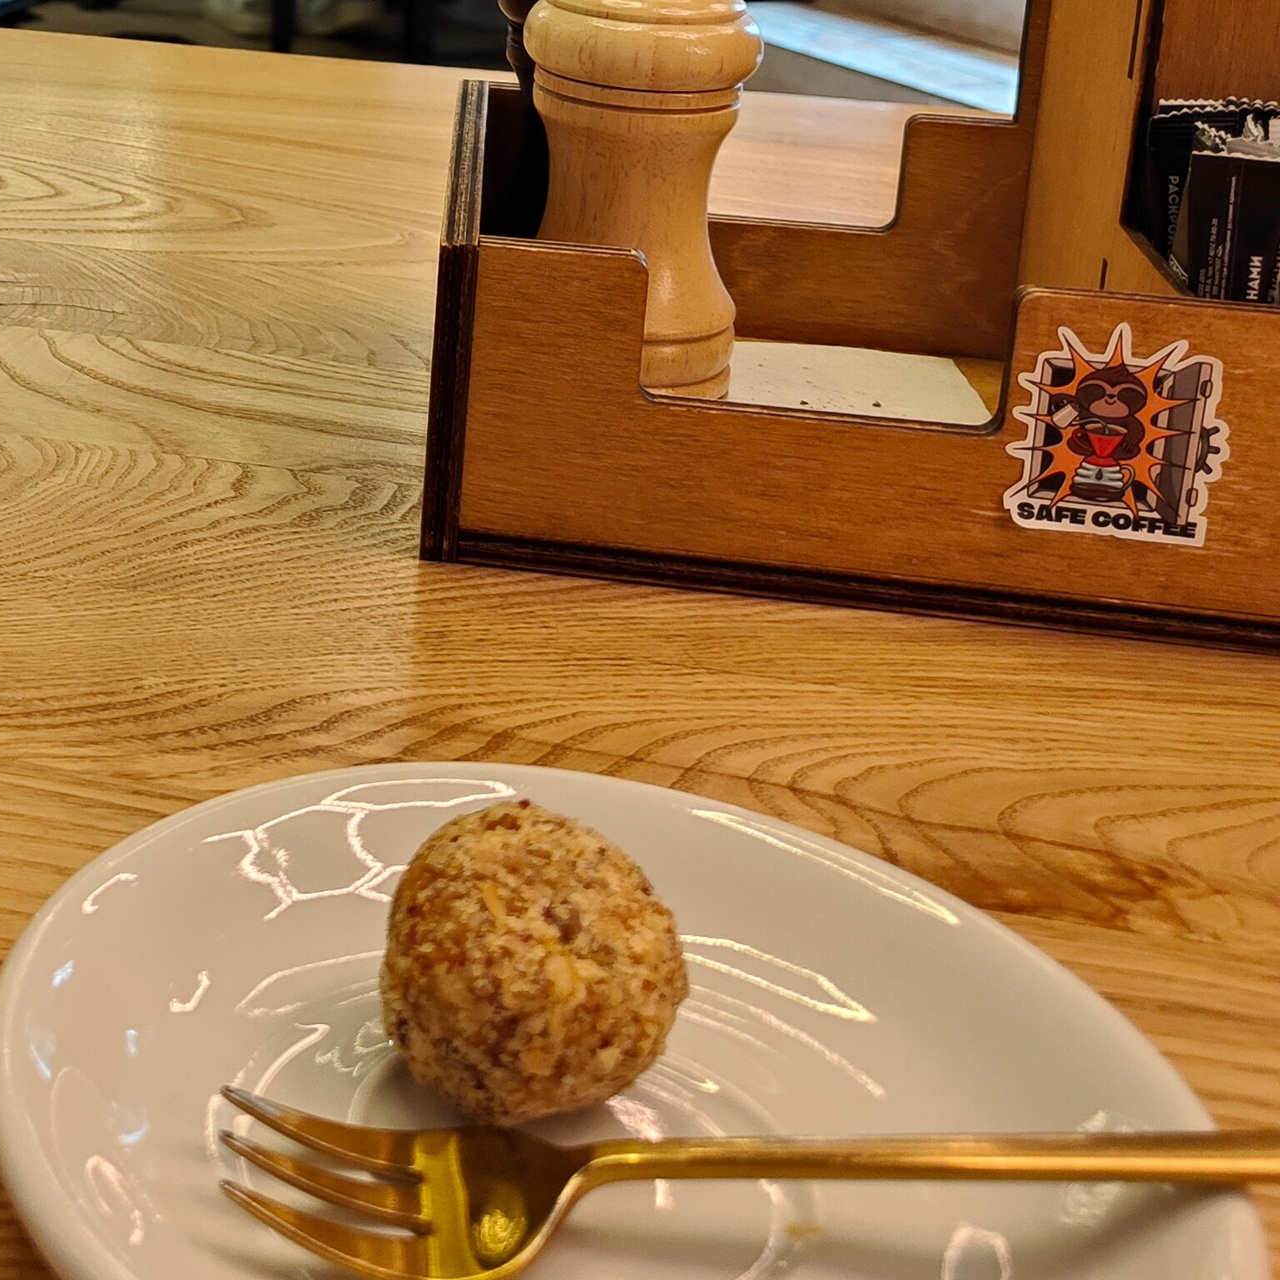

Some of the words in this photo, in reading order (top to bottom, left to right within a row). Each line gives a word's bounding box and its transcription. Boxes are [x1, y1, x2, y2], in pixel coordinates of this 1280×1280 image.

[1246, 256, 1263, 300] НАМИ
[1017, 502, 1087, 525] SAFE
[1091, 510, 1197, 539] COFFEE
